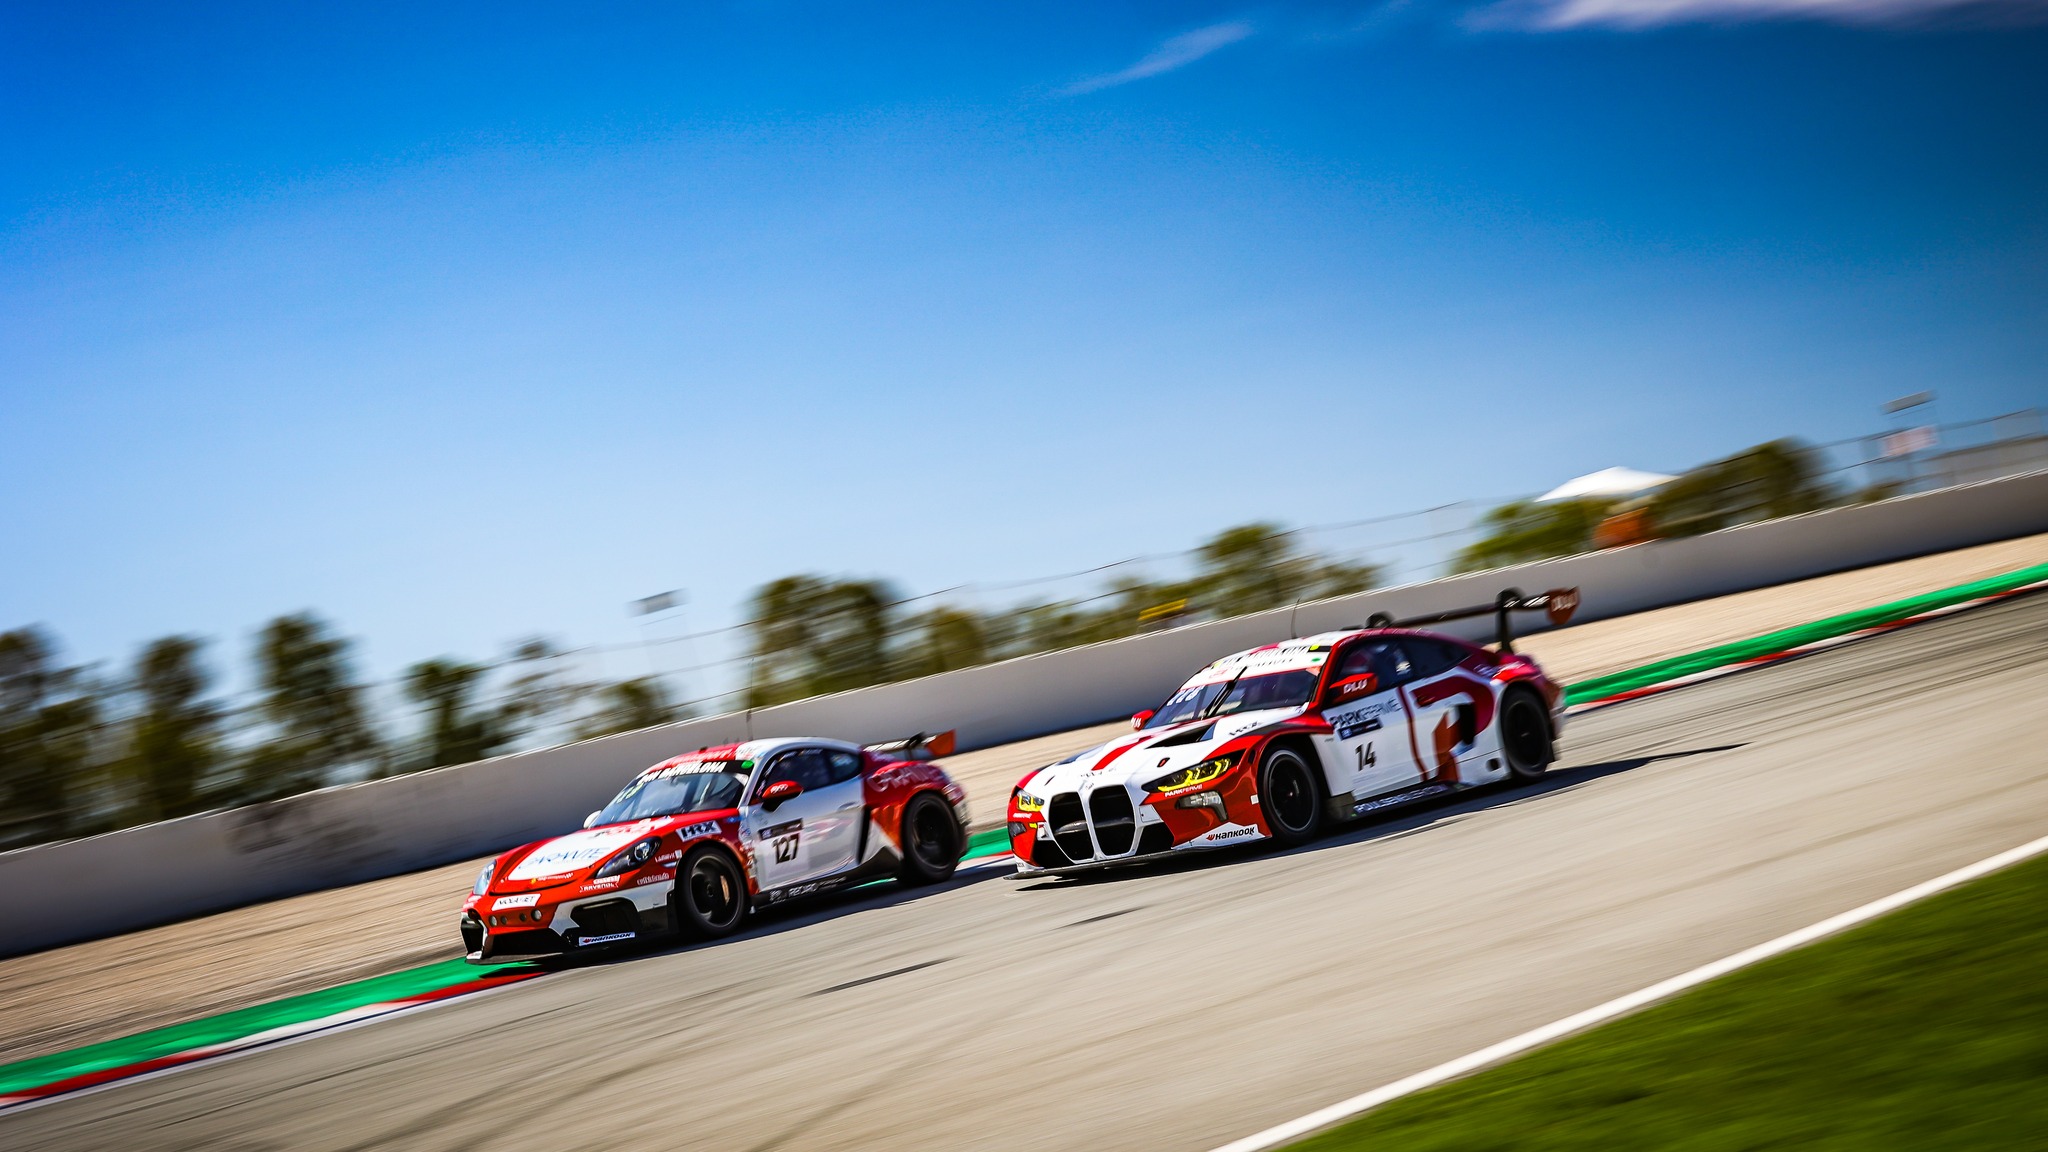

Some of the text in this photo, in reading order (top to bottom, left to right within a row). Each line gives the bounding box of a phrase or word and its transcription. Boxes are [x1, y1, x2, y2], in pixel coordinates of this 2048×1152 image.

[1342, 679, 1368, 694] DLU
[1354, 741, 1378, 772] 14
[658, 761, 728, 779] BARCELONA
[681, 821, 717, 838] HRX
[771, 832, 800, 865] 127
